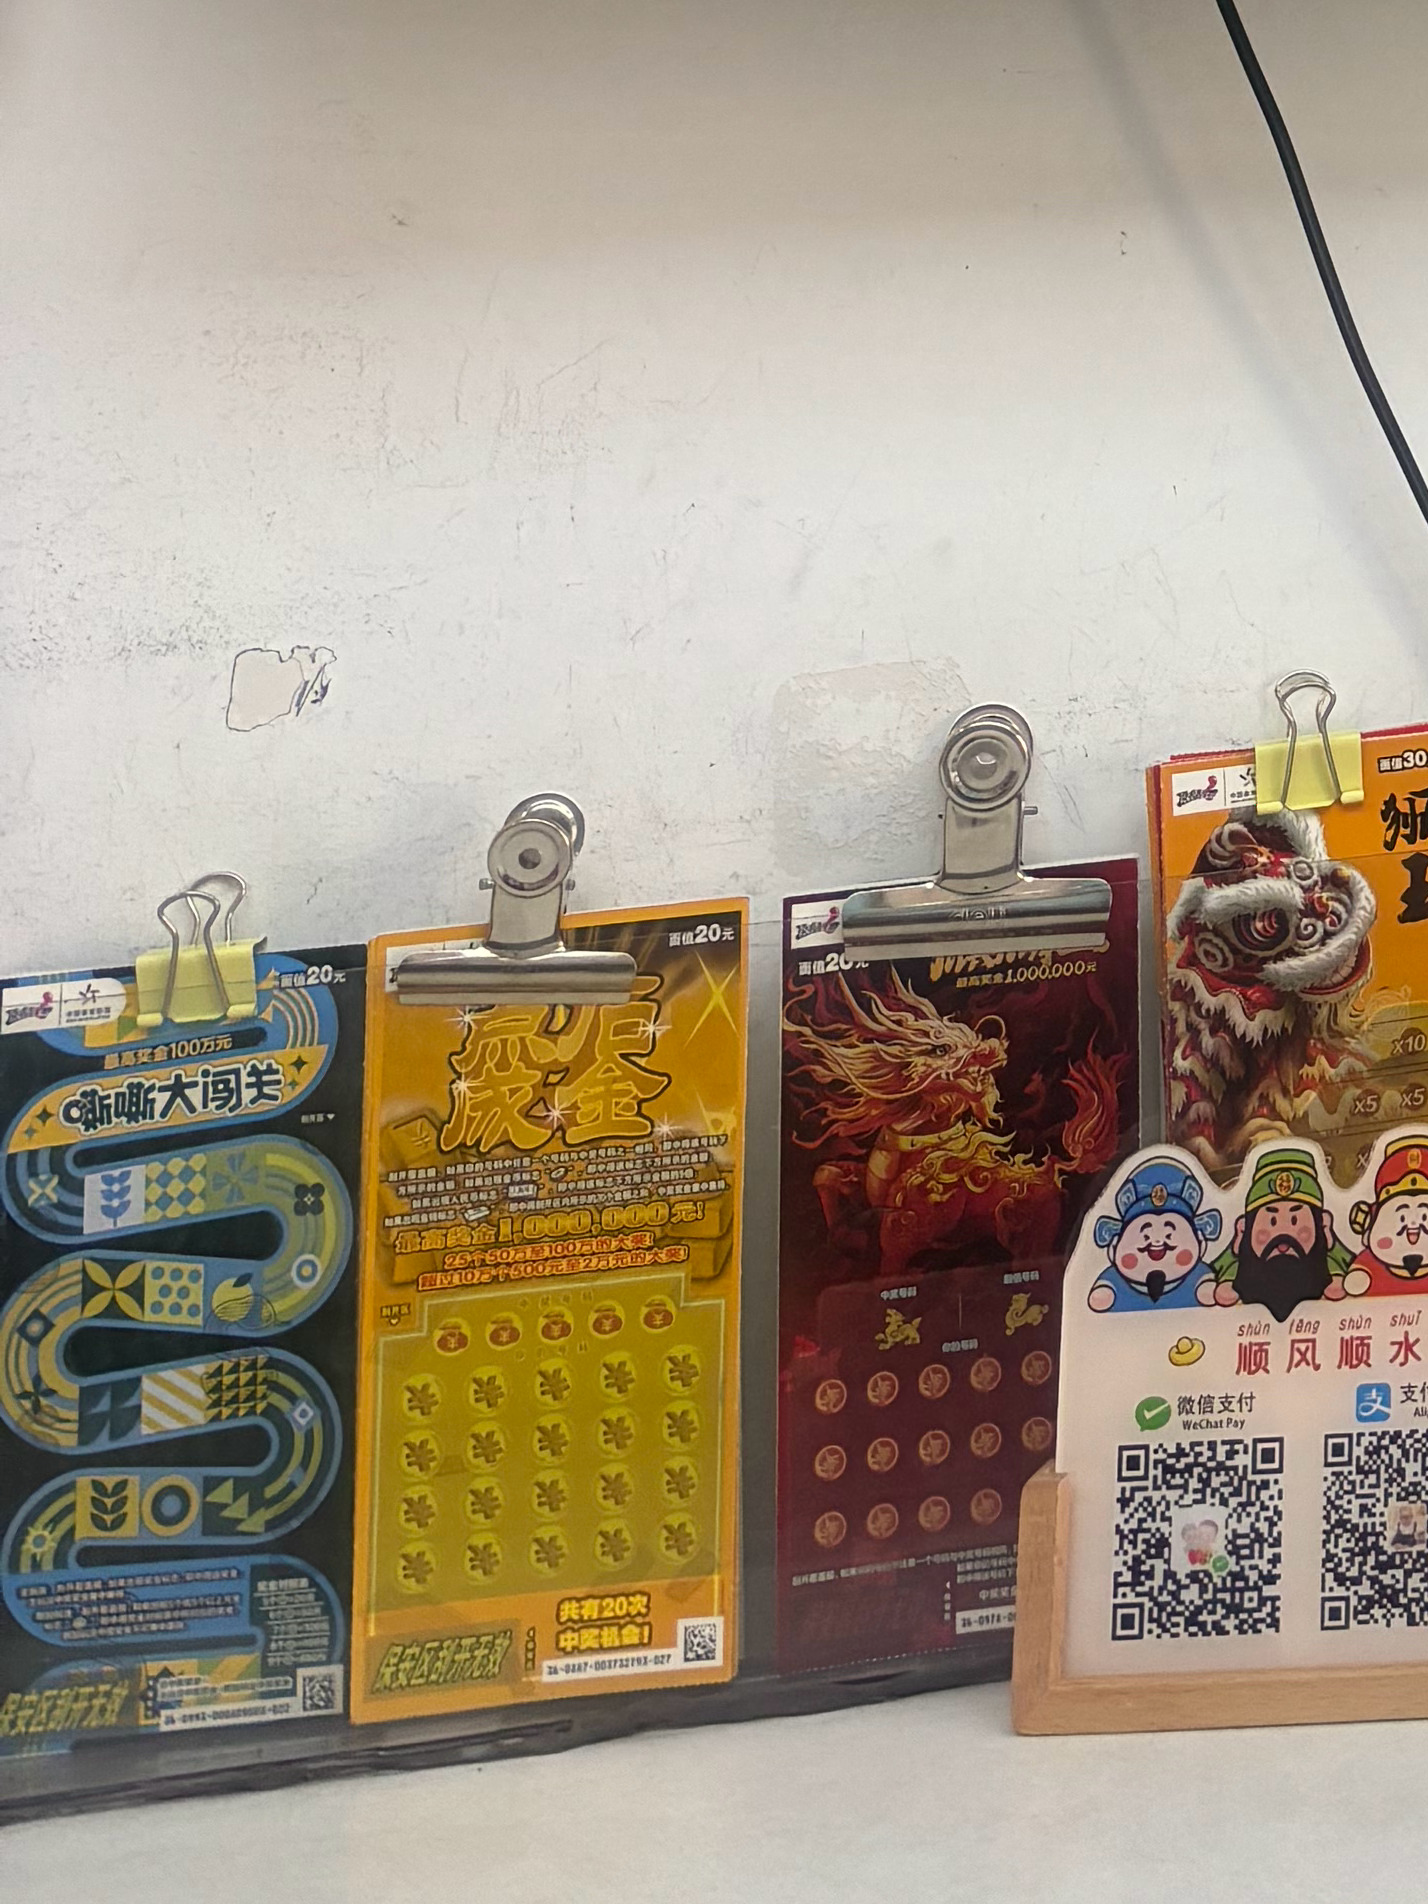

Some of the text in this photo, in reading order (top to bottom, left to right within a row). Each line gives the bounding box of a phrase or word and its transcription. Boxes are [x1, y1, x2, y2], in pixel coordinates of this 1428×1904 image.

[669, 924, 735, 946] 面值20元
[281, 965, 346, 988] 面值20元
[104, 1035, 232, 1069] 最高奖金100万元
[1237, 1320, 1270, 1337] shùn
[1339, 1313, 1372, 1333] shùn
[1177, 1392, 1256, 1416] 微信支付
[1182, 1417, 1221, 1431] WeChat
[1225, 1416, 1245, 1432] Pay
[558, 1594, 649, 1622] 共有20次
[558, 1623, 650, 1652] 中奖机会!
[373, 1632, 512, 1691] 保安区刮开无效
